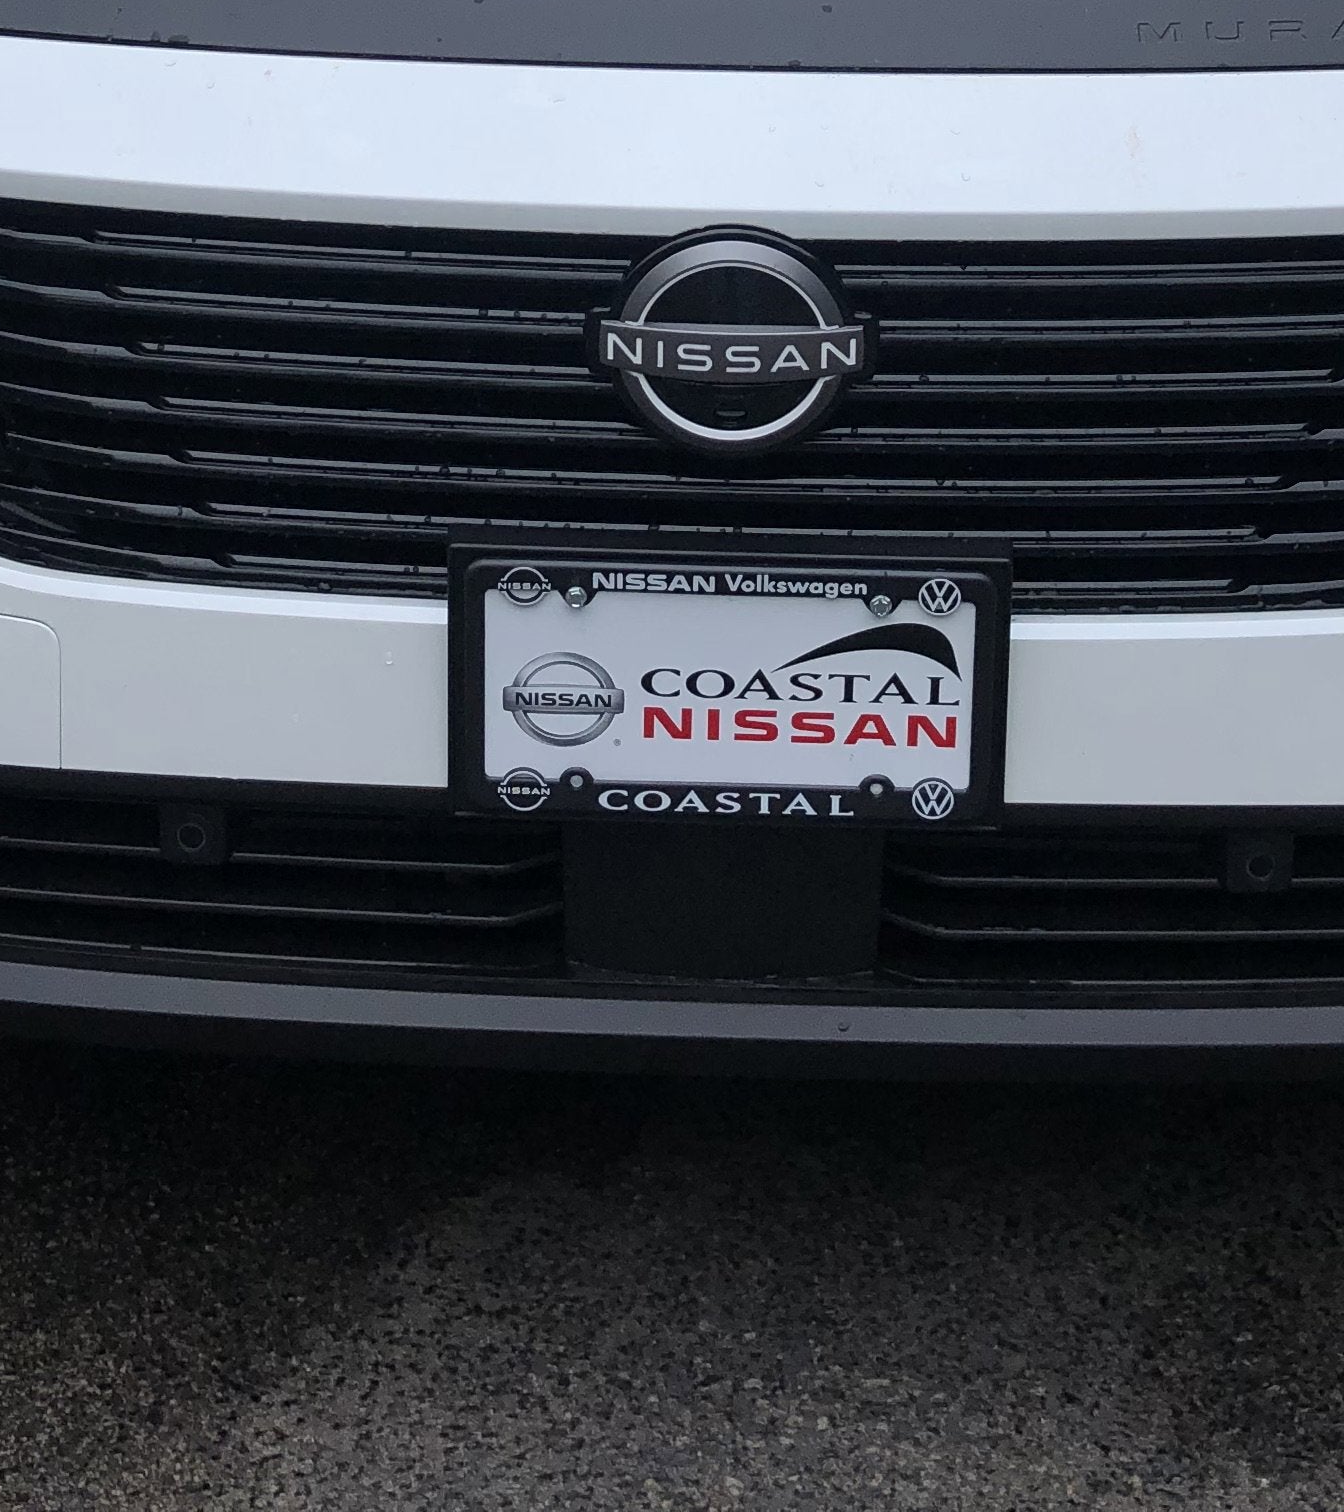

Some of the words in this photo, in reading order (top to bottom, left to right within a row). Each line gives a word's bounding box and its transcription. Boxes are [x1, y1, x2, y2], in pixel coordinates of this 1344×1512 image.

[606, 332, 857, 374] NISSAN
[497, 581, 552, 591] NISSAN
[592, 572, 716, 593] NISSAN
[724, 573, 868, 599] Volkswagen
[514, 691, 613, 708] NISSAN
[640, 668, 960, 707] COASTAL
[642, 706, 958, 749] NISSAN
[497, 786, 551, 796] NISSAN
[597, 789, 854, 817] COASTAL
